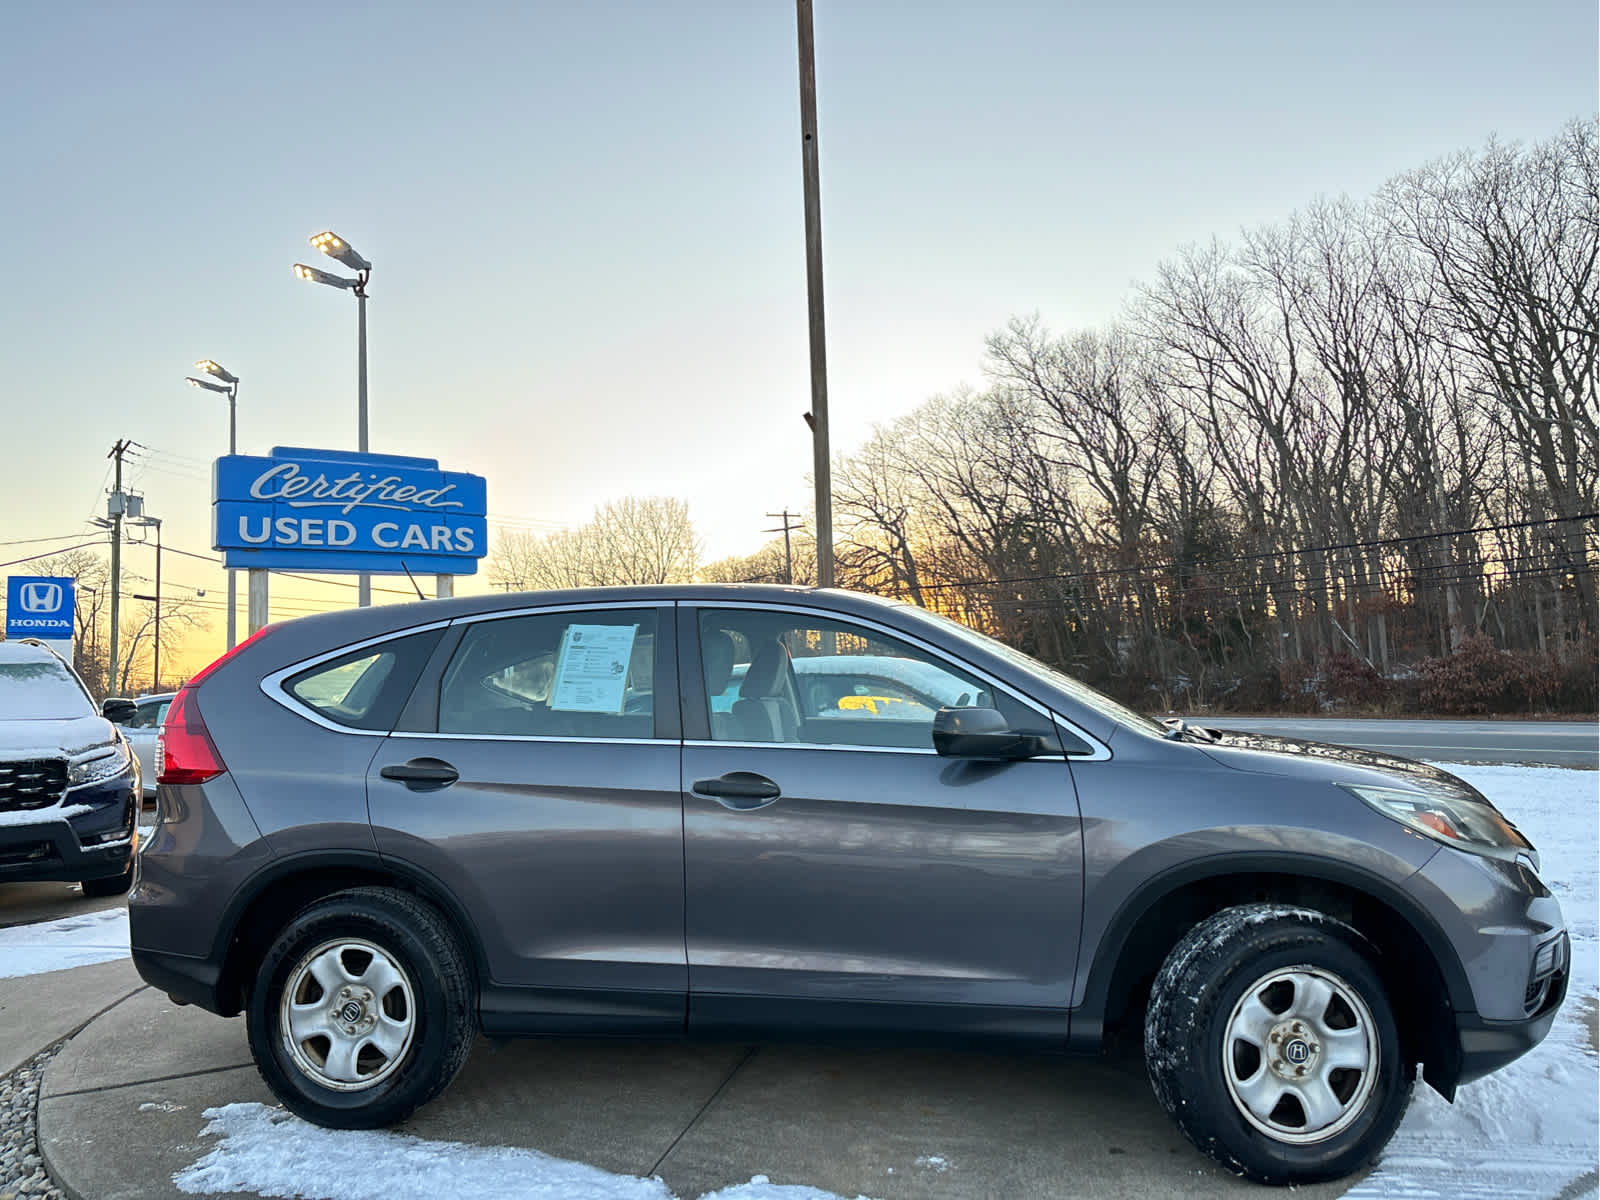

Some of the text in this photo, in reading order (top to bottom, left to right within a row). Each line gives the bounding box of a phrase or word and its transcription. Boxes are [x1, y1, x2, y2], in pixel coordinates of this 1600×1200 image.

[250, 463, 463, 515] Certified
[239, 516, 475, 552] USED CARS
[10, 619, 70, 627] HONDA
